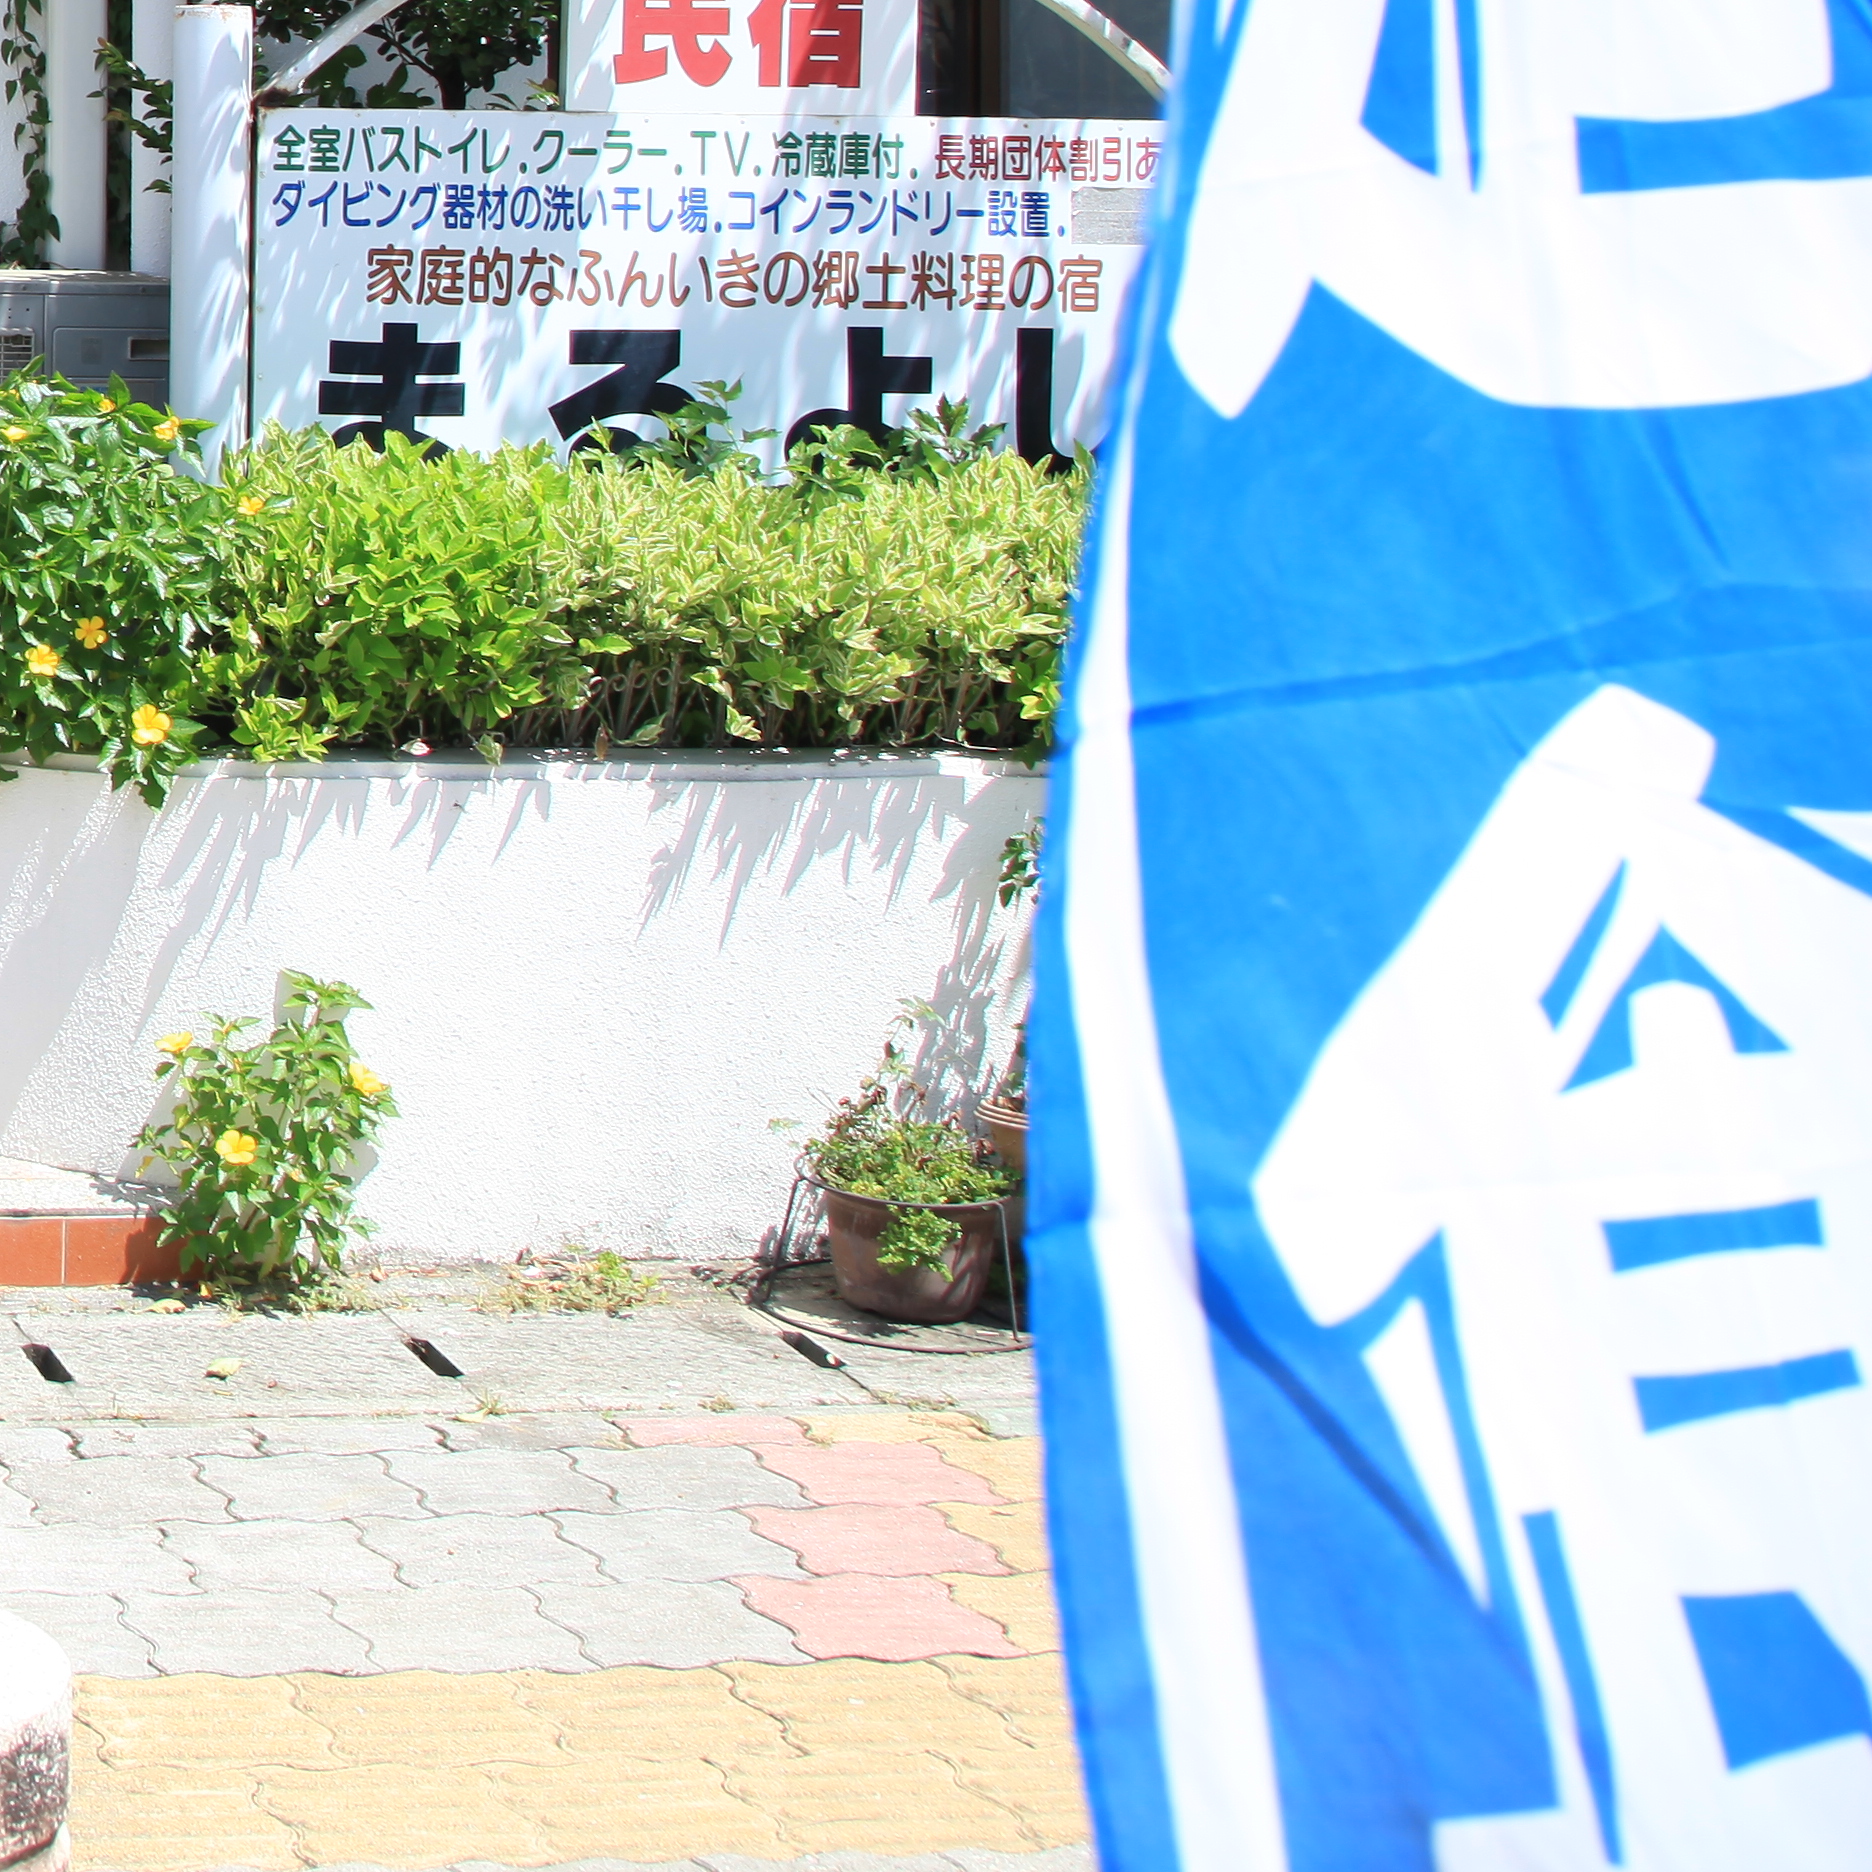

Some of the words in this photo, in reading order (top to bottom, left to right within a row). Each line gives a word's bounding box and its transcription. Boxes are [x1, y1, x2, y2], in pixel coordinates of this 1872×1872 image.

[365, 244, 1104, 313] 家庭的なふんいきの郷土料理の宿
